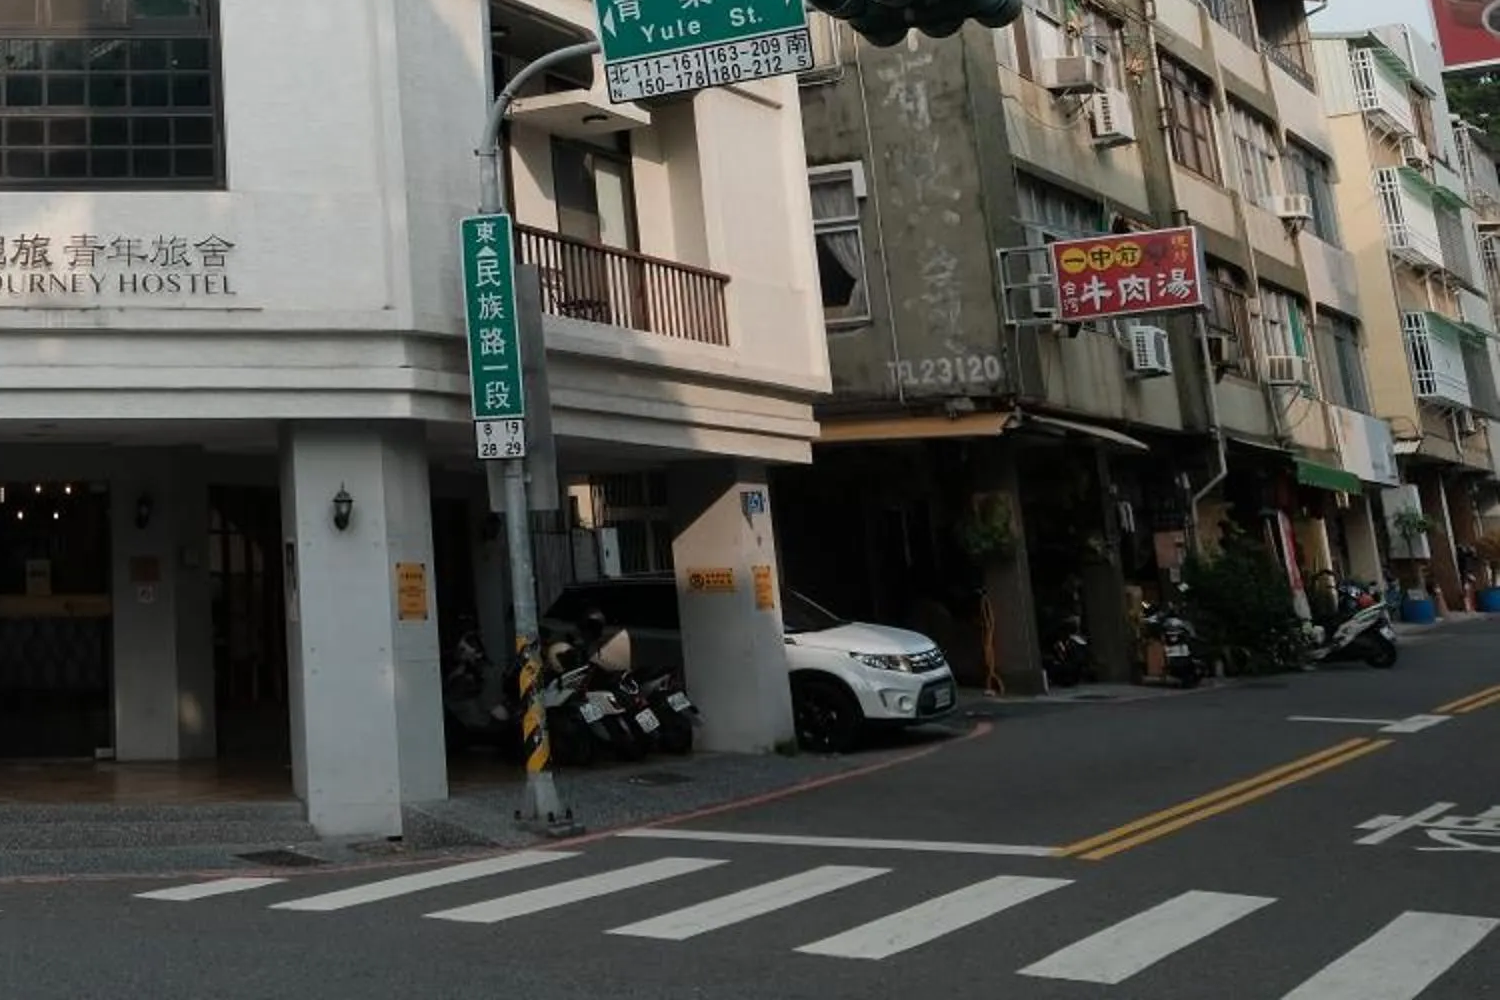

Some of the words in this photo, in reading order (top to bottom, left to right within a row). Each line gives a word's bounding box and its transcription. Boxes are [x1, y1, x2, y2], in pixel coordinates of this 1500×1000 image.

[641, 18, 701, 43] Yule
[729, 6, 763, 27] St.
[610, 66, 631, 85] 北
[633, 52, 701, 79] 111-161
[709, 37, 781, 64] 163-209
[786, 34, 807, 55] 南
[638, 71, 705, 97] 150-178
[713, 55, 783, 83] 180-212
[476, 221, 496, 243] 東
[118, 272, 237, 296] HOSTEL
[1080, 267, 1195, 311] 牛肉湯
[475, 258, 511, 410] 民族路一段
[505, 421, 519, 435] 19
[483, 443, 498, 456] 28
[505, 441, 521, 455] 29
